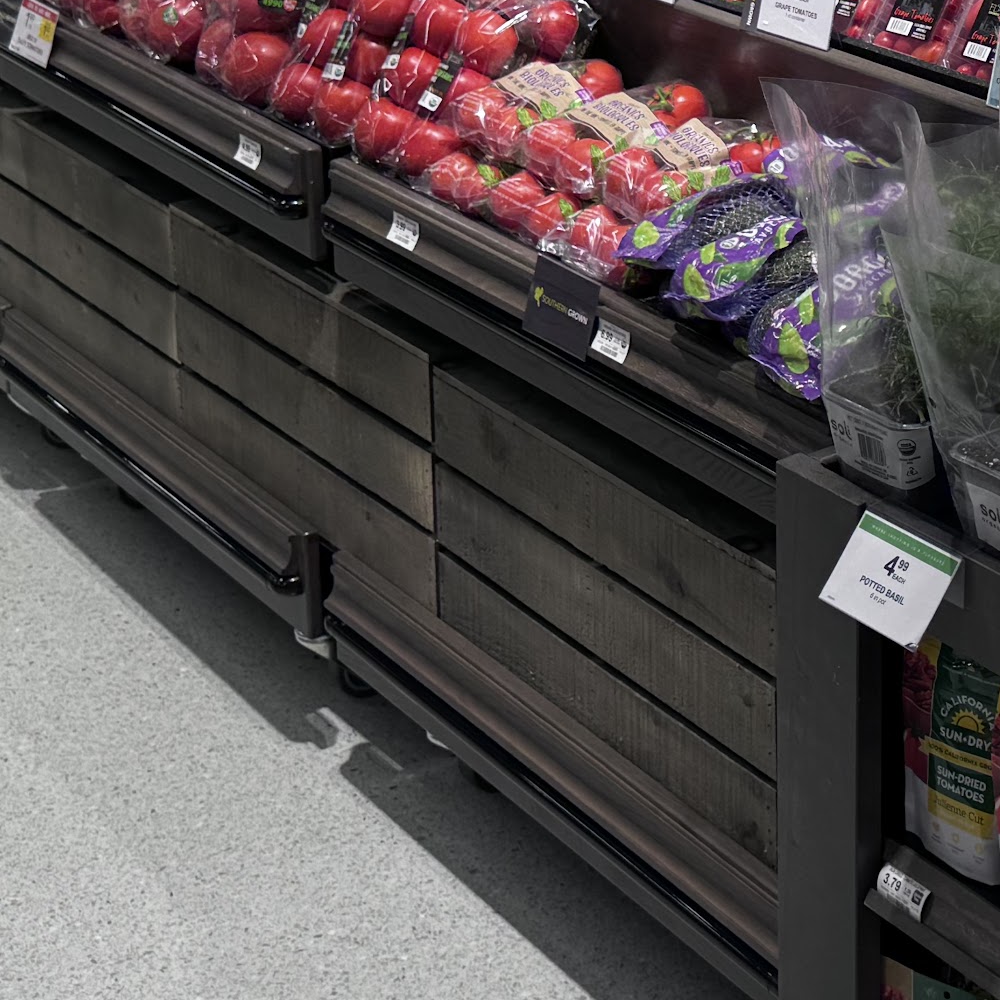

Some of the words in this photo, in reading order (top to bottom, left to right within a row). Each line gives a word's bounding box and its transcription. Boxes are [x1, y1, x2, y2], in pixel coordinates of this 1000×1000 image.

[775, 1, 791, 12] GRAPE
[792, 5, 818, 20] TOMATOES
[567, 309, 589, 326] GROWN
[892, 573, 907, 585] EACH
[859, 575, 886, 595] POTTED
[885, 588, 905, 606] BASIL
[936, 764, 987, 792] SUN-DRIED
[936, 776, 985, 805] TOMATOES
[882, 872, 902, 892] 3.79
